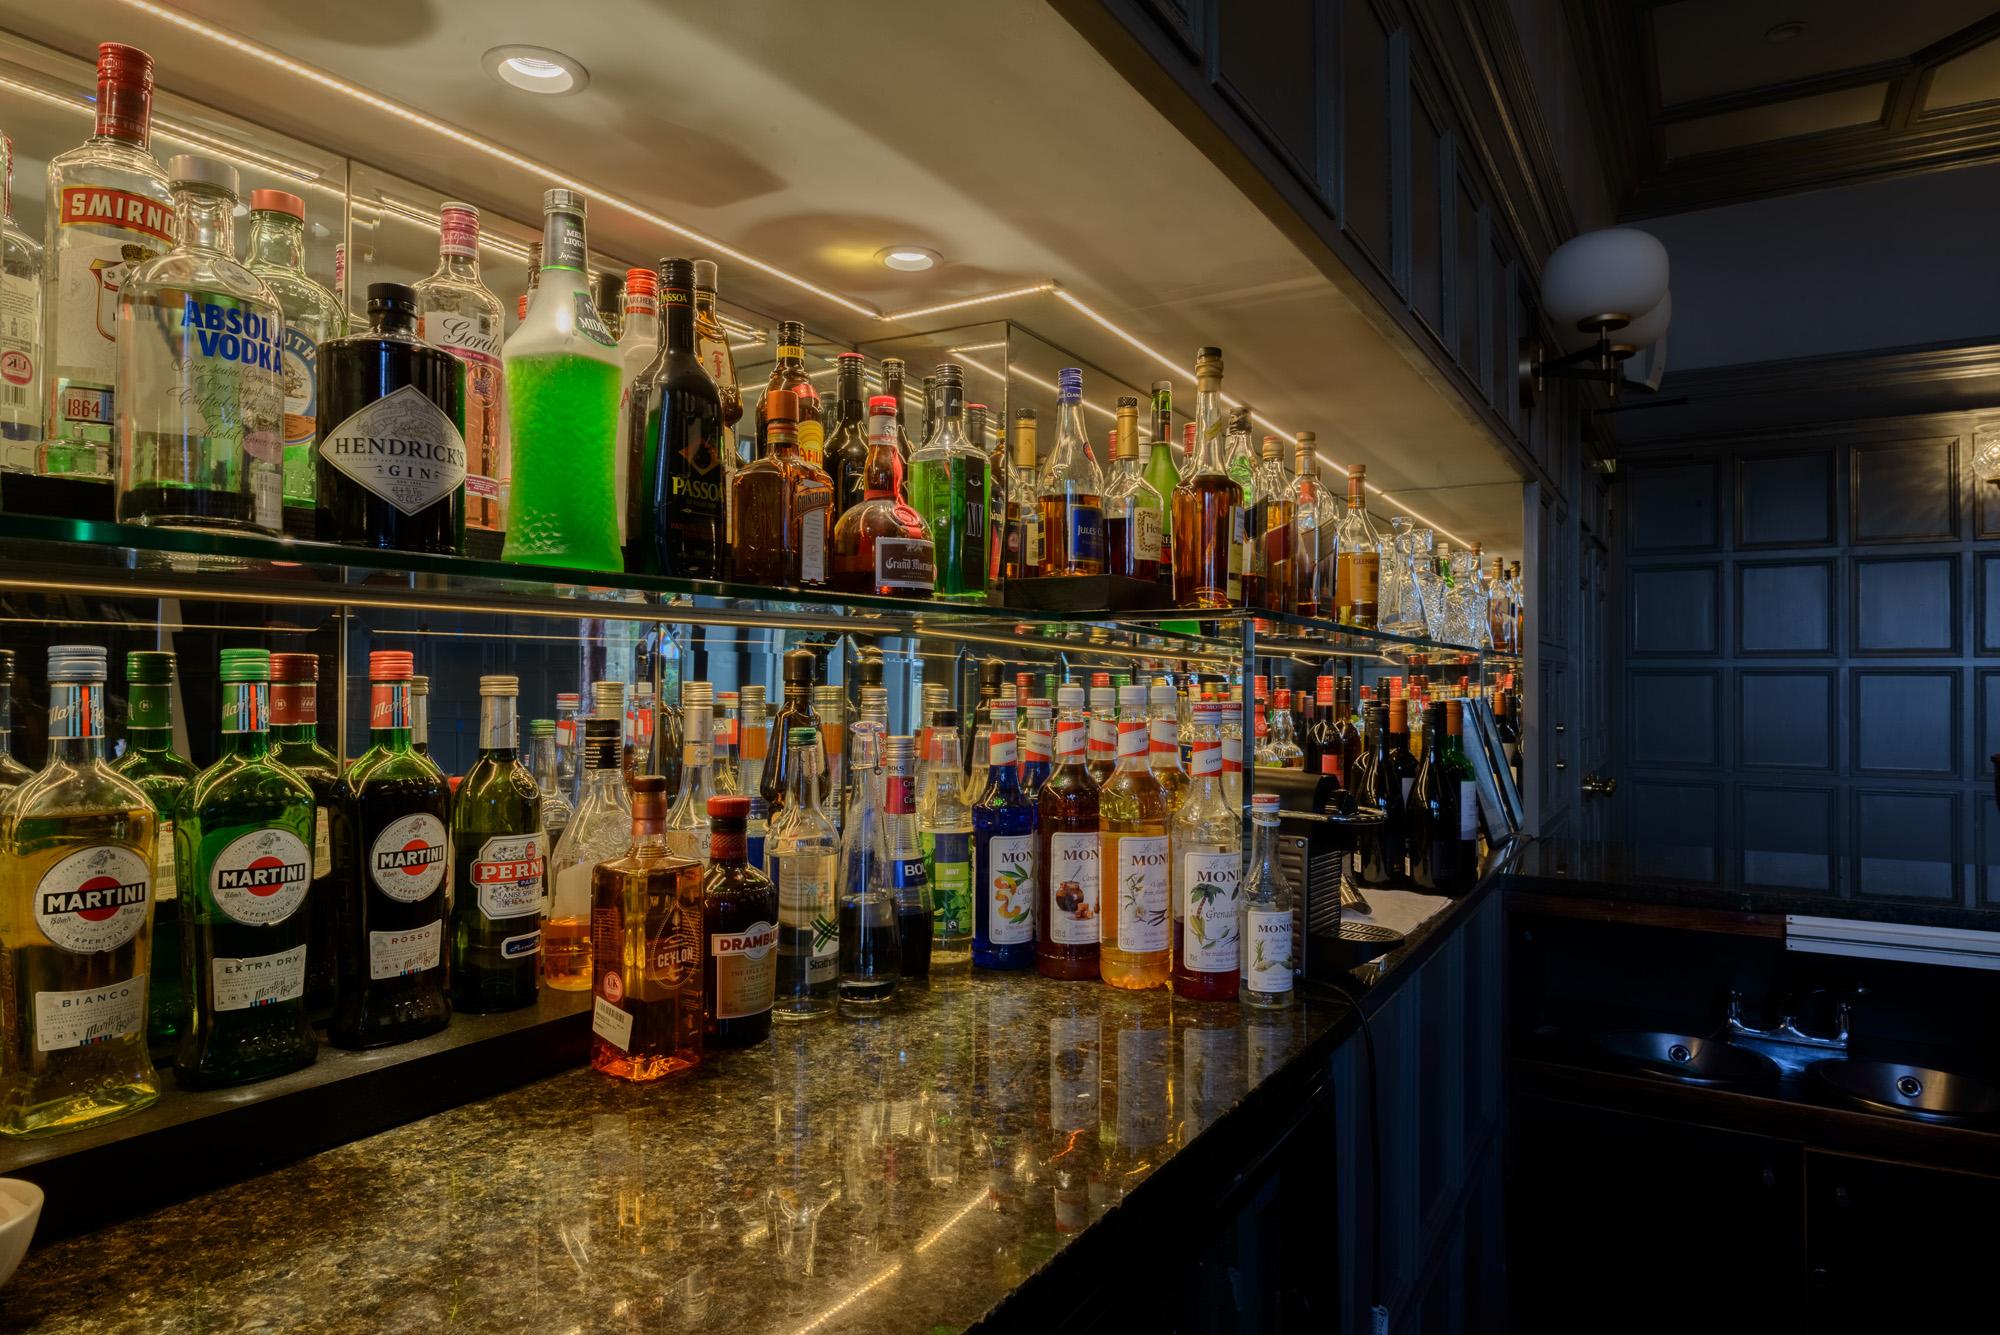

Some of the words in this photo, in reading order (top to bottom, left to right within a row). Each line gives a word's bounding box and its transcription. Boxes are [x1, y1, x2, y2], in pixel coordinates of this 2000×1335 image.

[660, 292, 687, 305] PASSOA
[197, 330, 283, 376] VODKA
[67, 398, 100, 418] 1864
[335, 437, 465, 469] HENDRICK'S
[388, 464, 431, 480] GIN
[1077, 524, 1097, 539] JULES
[885, 556, 911, 570] Grand
[380, 845, 443, 870] MARTINI
[221, 864, 304, 888] MARTINI
[47, 882, 144, 914] MARTINI
[391, 931, 431, 945] ROSSO
[225, 961, 271, 974] EXTRA
[276, 954, 300, 967] DRY
[657, 948, 693, 969] CEYLON
[62, 988, 129, 1008] BIANCO
